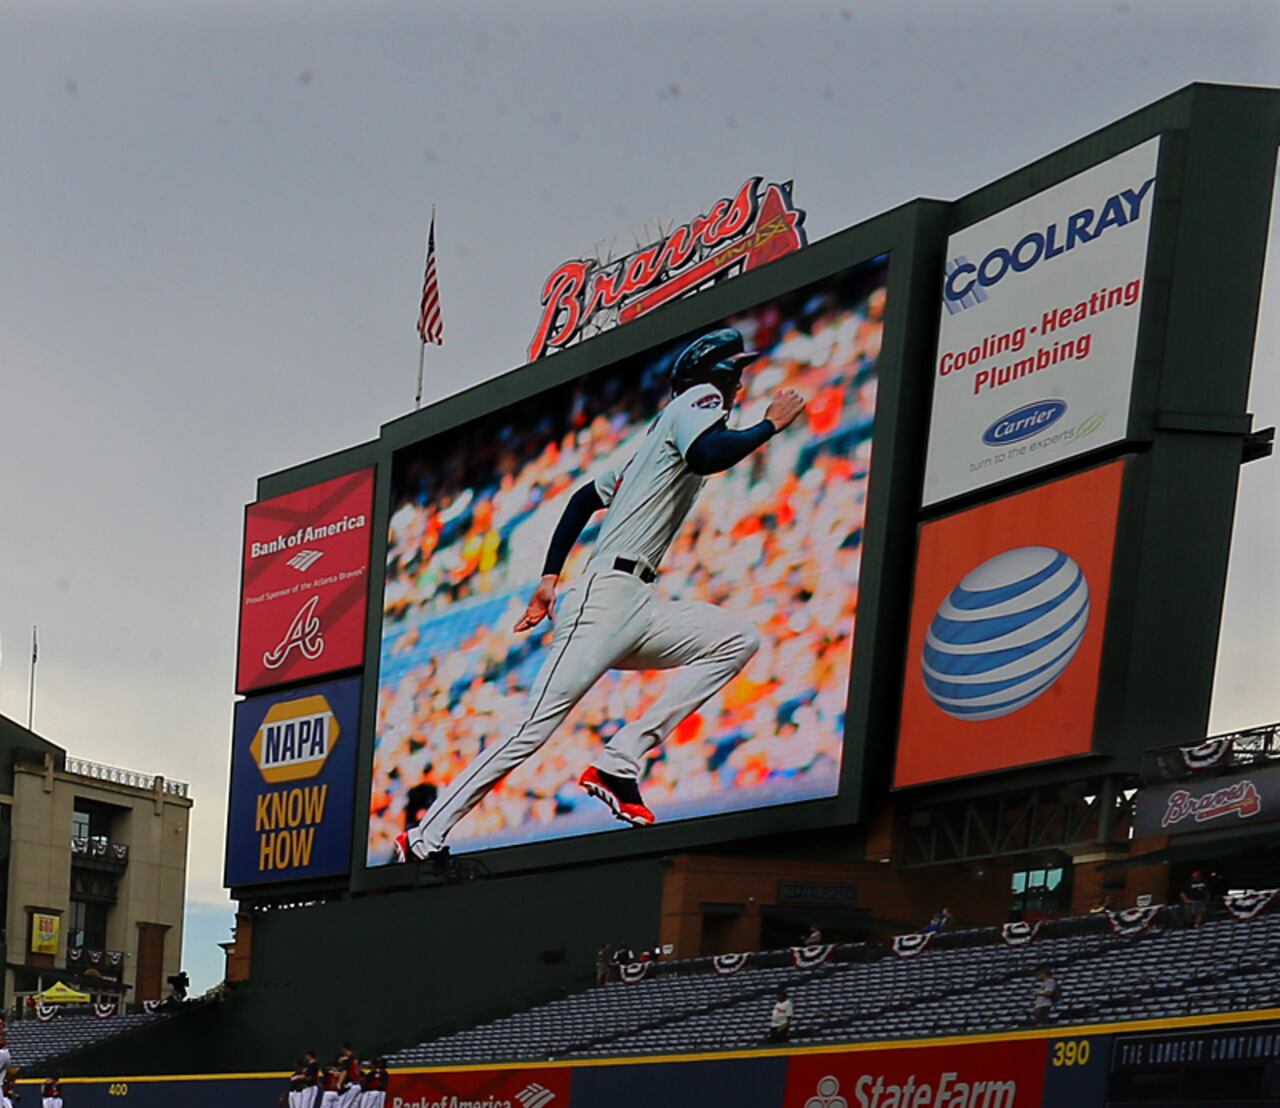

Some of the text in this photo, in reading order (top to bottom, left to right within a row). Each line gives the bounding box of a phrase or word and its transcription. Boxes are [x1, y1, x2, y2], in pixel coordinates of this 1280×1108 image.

[945, 176, 1158, 302] COOLRAY
[526, 176, 764, 364] Braves
[939, 279, 1141, 377] Cooling Heating
[973, 332, 1093, 395] Plumbing
[992, 406, 1056, 439] Carrier
[969, 427, 1075, 473] turn to the experts
[250, 513, 366, 559] Bank of America
[265, 717, 325, 765] NAPA
[255, 784, 328, 832] KNOW
[258, 827, 315, 871] HOW
[1052, 1039, 1090, 1067] 390
[1121, 1044, 1143, 1065] THE
[1148, 1039, 1204, 1064] LONGEST
[108, 1083, 128, 1096] 400
